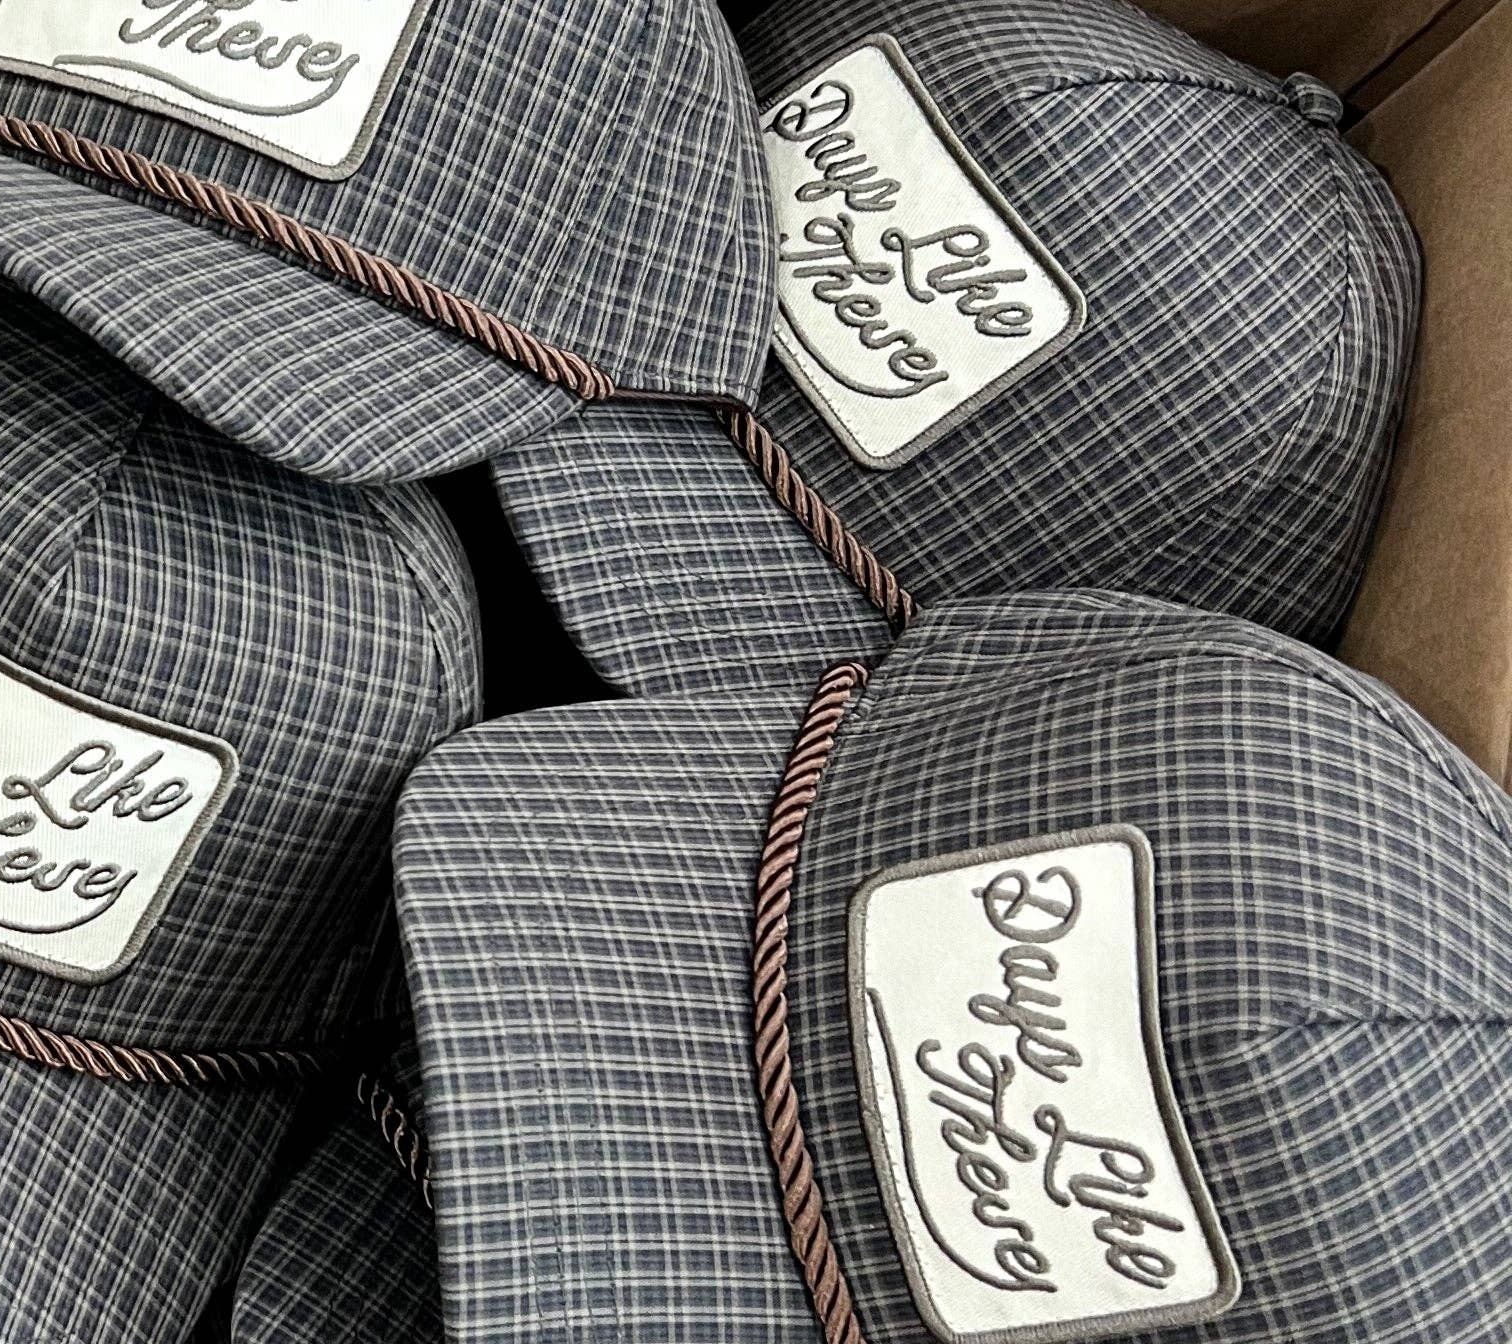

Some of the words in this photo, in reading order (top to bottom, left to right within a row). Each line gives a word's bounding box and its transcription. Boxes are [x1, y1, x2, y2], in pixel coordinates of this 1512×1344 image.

[764, 80, 901, 211] Days
[881, 226, 1033, 337] Like
[778, 213, 949, 398] These
[2, 740, 194, 830] Like
[866, 1039, 1058, 1292] These
[969, 866, 1083, 1083] Days
[1034, 1104, 1185, 1289] Like
